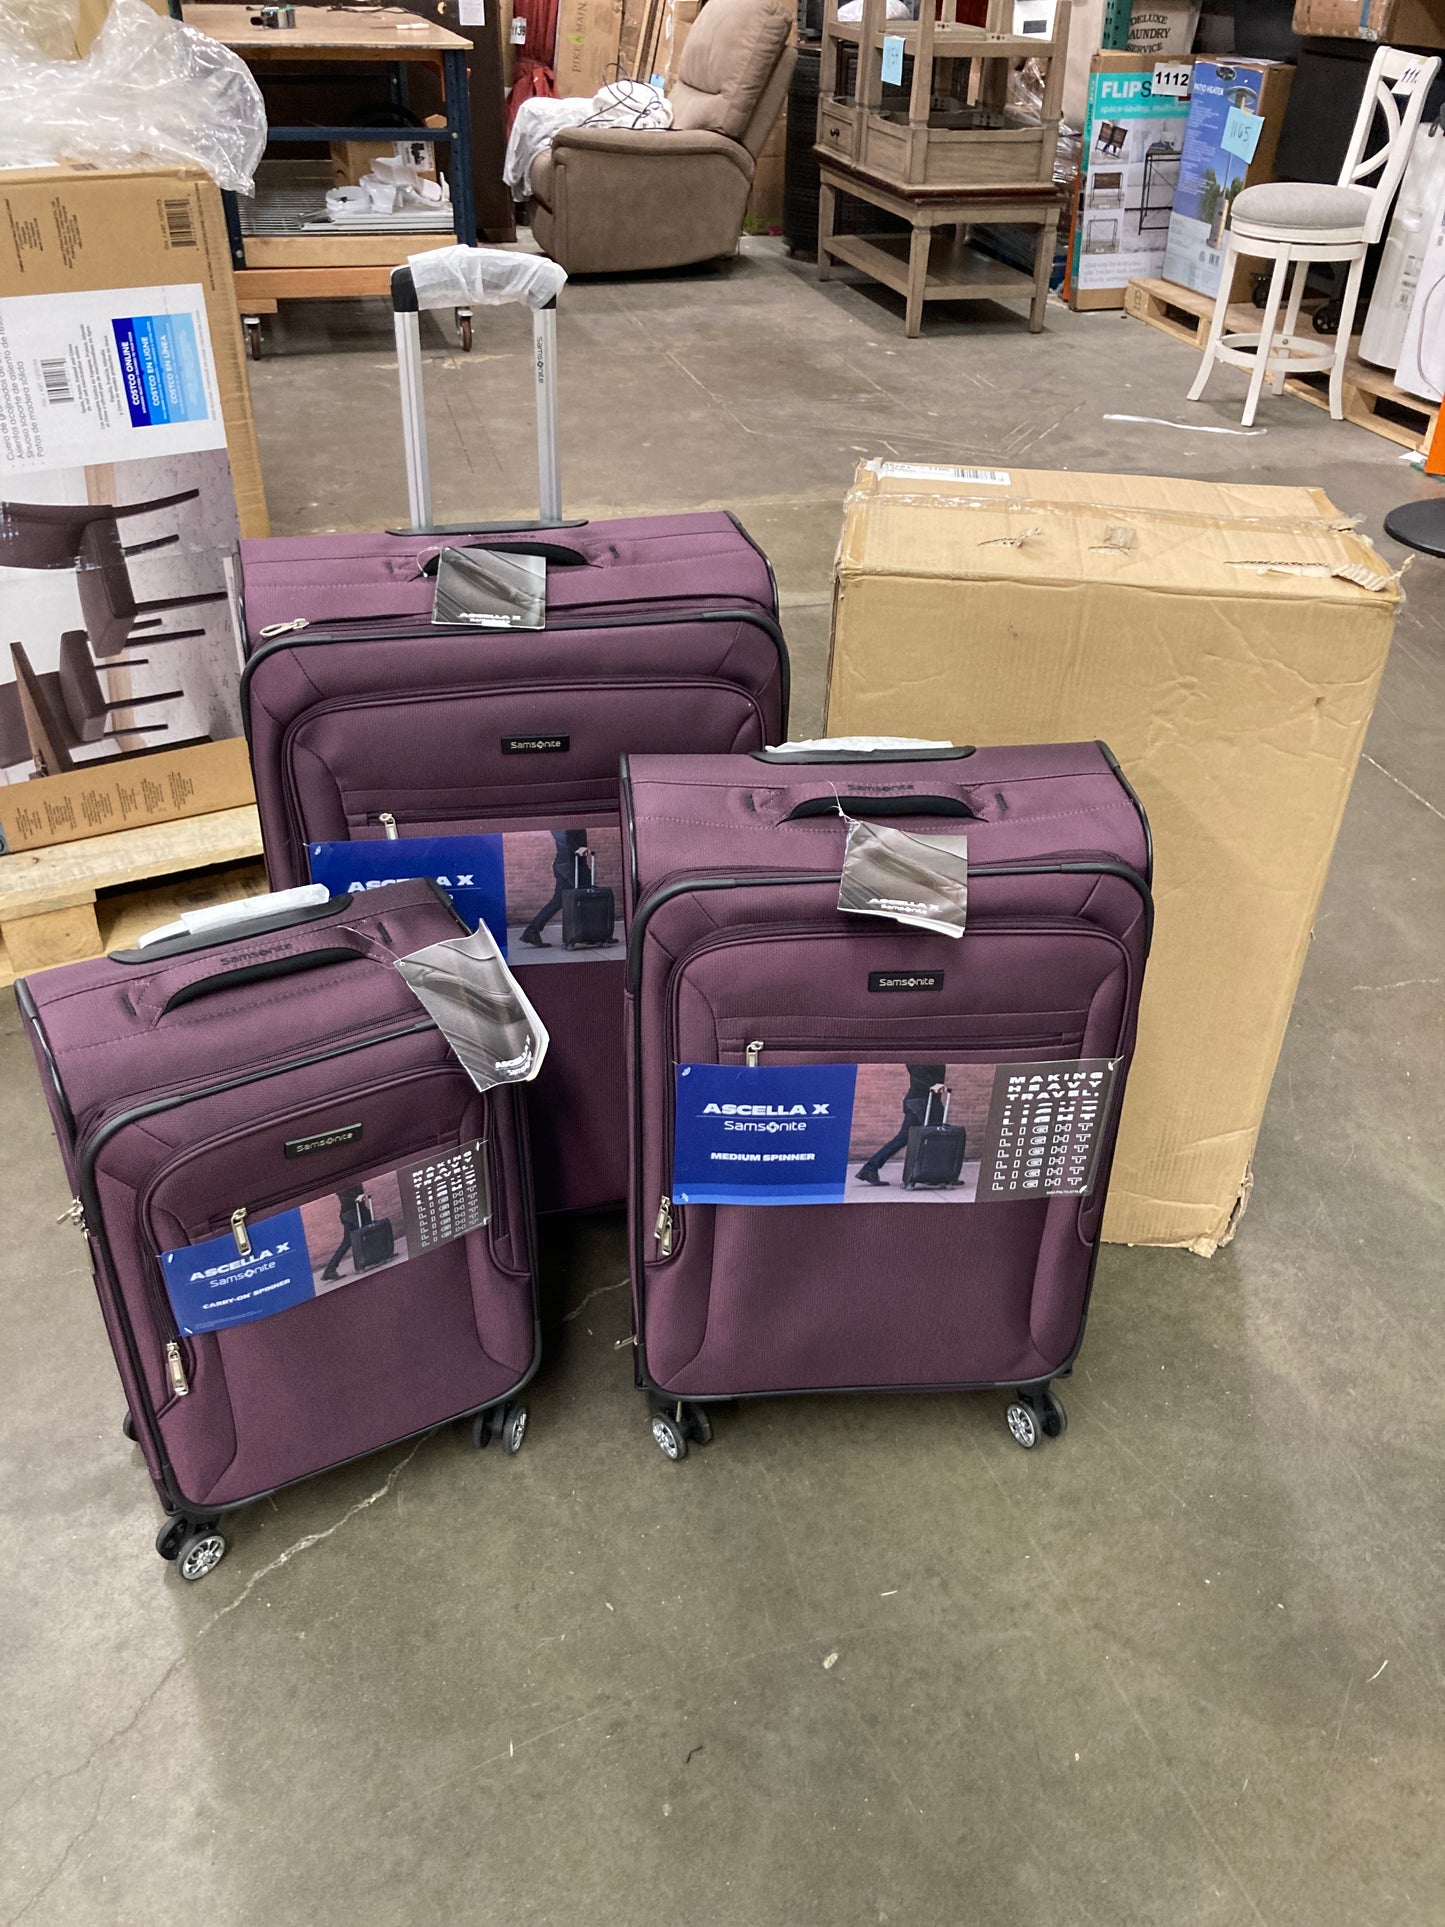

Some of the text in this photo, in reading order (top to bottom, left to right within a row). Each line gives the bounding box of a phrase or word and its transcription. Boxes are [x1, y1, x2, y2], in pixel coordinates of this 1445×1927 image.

[1131, 15, 1168, 24] DELUXE
[1128, 28, 1171, 40] AUNDRY
[1155, 72, 1189, 86] 1112
[1402, 68, 1421, 83] 111
[1193, 83, 1224, 96] PATIO HEATER
[121, 340, 133, 372] ONLINE
[140, 335, 151, 360] LIGNE
[3, 349, 16, 381] asiento
[145, 361, 153, 373] EN
[163, 359, 172, 371] EN
[10, 382, 19, 394] de
[127, 373, 140, 405] COSTCO
[148, 374, 160, 406] COSTCO
[165, 372, 179, 404] COSTCO
[14, 395, 28, 426] soporte
[22, 386, 35, 420] madera
[29, 422, 38, 433] de
[3, 435, 14, 461] Cuero
[11, 426, 24, 459] Asientos
[21, 427, 34, 459] Sinuoso
[33, 434, 44, 457] Patas
[510, 740, 561, 749] Samsonite
[457, 875, 474, 886] X
[220, 944, 292, 966] Samsonite
[879, 977, 935, 987] Samsonite
[1008, 1081, 1101, 1092] HEAVY
[1010, 1072, 1103, 1084] MAKING
[1007, 1090, 1099, 1101] TRAVEL.
[703, 1103, 830, 1116] ASCELLA X
[724, 1120, 807, 1133] Samsonite
[297, 1133, 352, 1152] Samsonite
[412, 1151, 472, 1178] MAKING
[711, 1152, 815, 1161] MEDIUM SPINNER
[190, 1242, 290, 1281] ASCELLA X
[210, 1262, 276, 1287] Samsonite
[202, 1278, 290, 1309] CARRY-ON SPINNER
